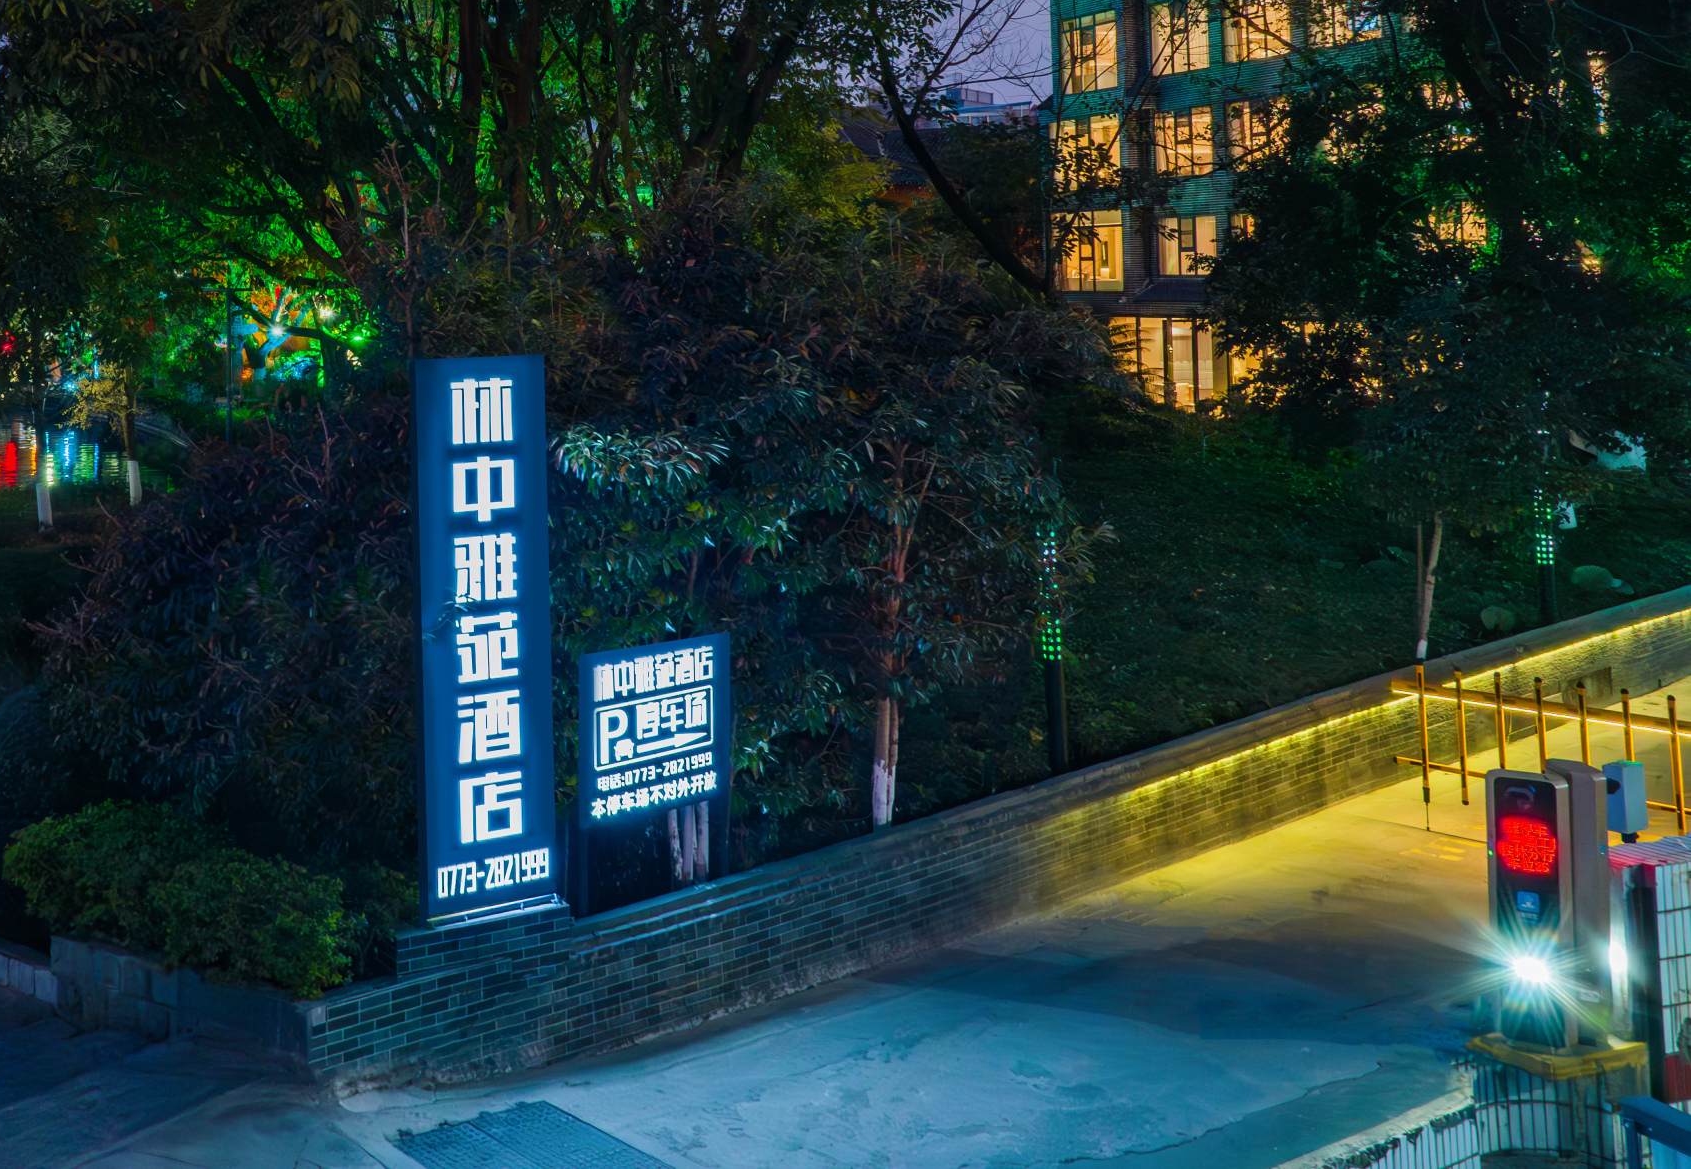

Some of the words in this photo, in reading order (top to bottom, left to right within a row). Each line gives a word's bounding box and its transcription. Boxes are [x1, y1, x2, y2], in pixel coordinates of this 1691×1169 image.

[450, 376, 522, 845] 林中雅苑酒店
[593, 646, 714, 703] 林中雅苑酒店
[636, 691, 708, 740] 停车场
[591, 770, 718, 819] 本停车场不对外开放
[437, 847, 550, 901] 0773-2821999
